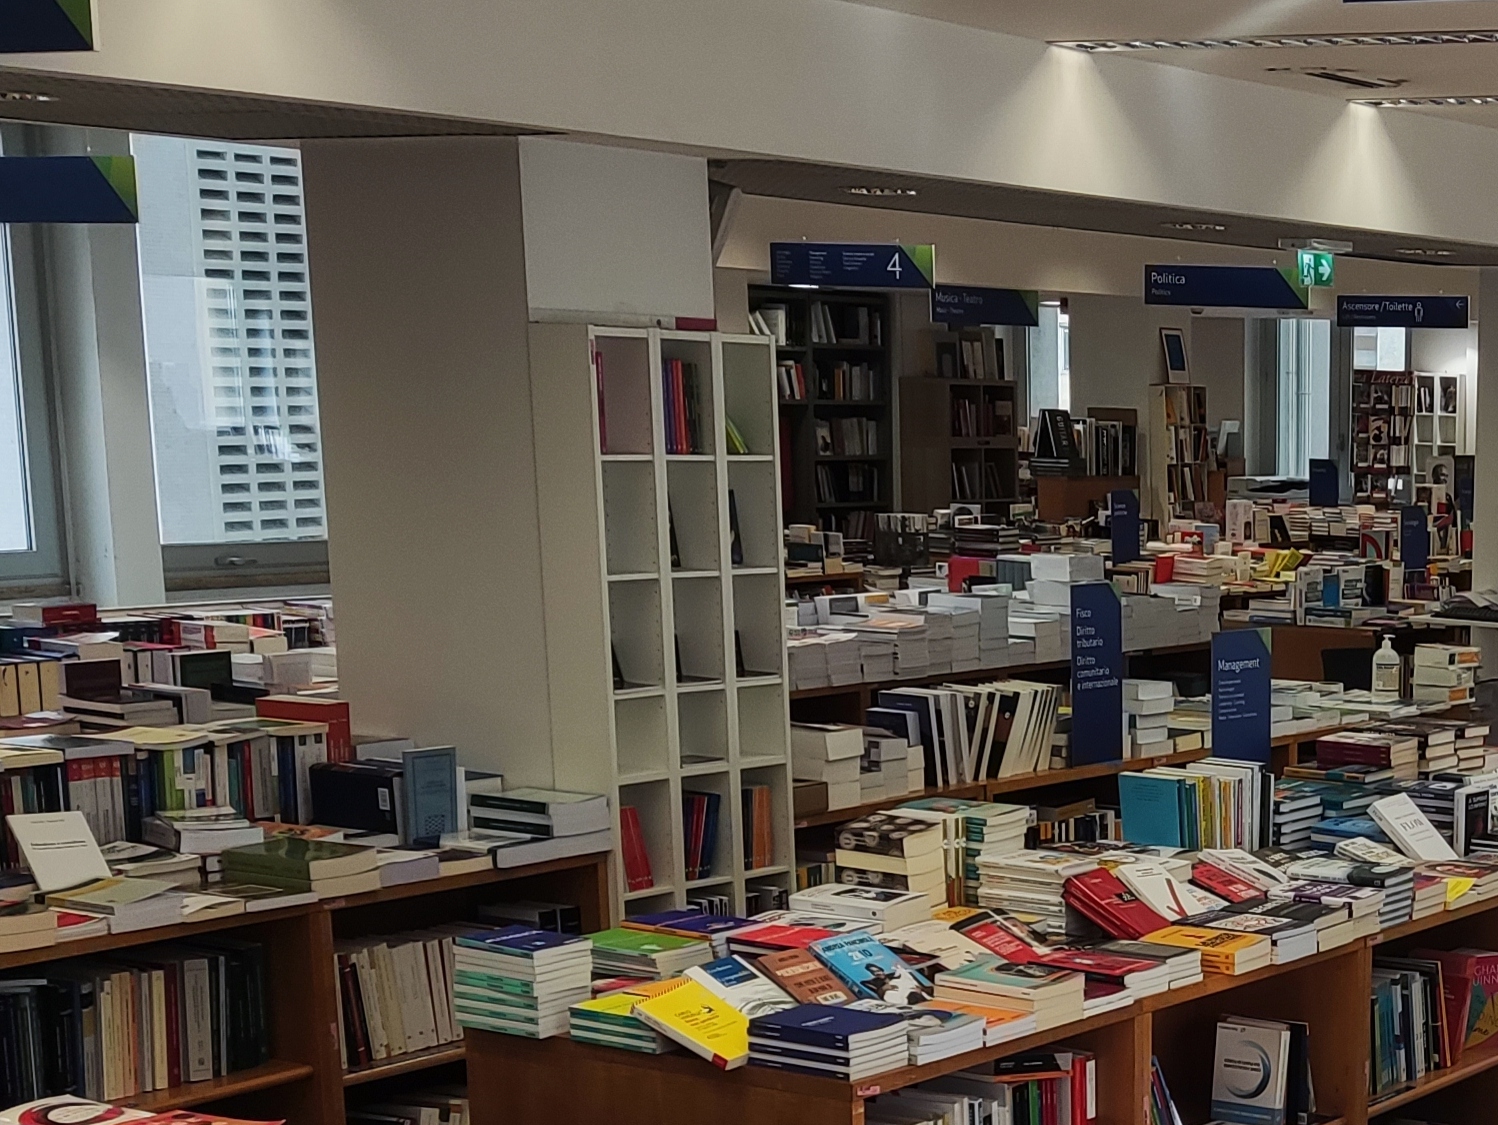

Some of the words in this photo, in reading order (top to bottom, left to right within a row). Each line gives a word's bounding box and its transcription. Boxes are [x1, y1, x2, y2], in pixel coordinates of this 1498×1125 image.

[886, 252, 903, 280] 4
[1151, 272, 1186, 285] Politica
[934, 291, 958, 304] Musica
[1076, 608, 1092, 618] Fisco
[1076, 626, 1095, 636] Diritto
[1076, 638, 1103, 648] tributario
[1077, 655, 1096, 666] Diritto
[1218, 657, 1260, 674] Management
[1077, 667, 1110, 679] comunitario
[1081, 678, 1119, 690] internazionale
